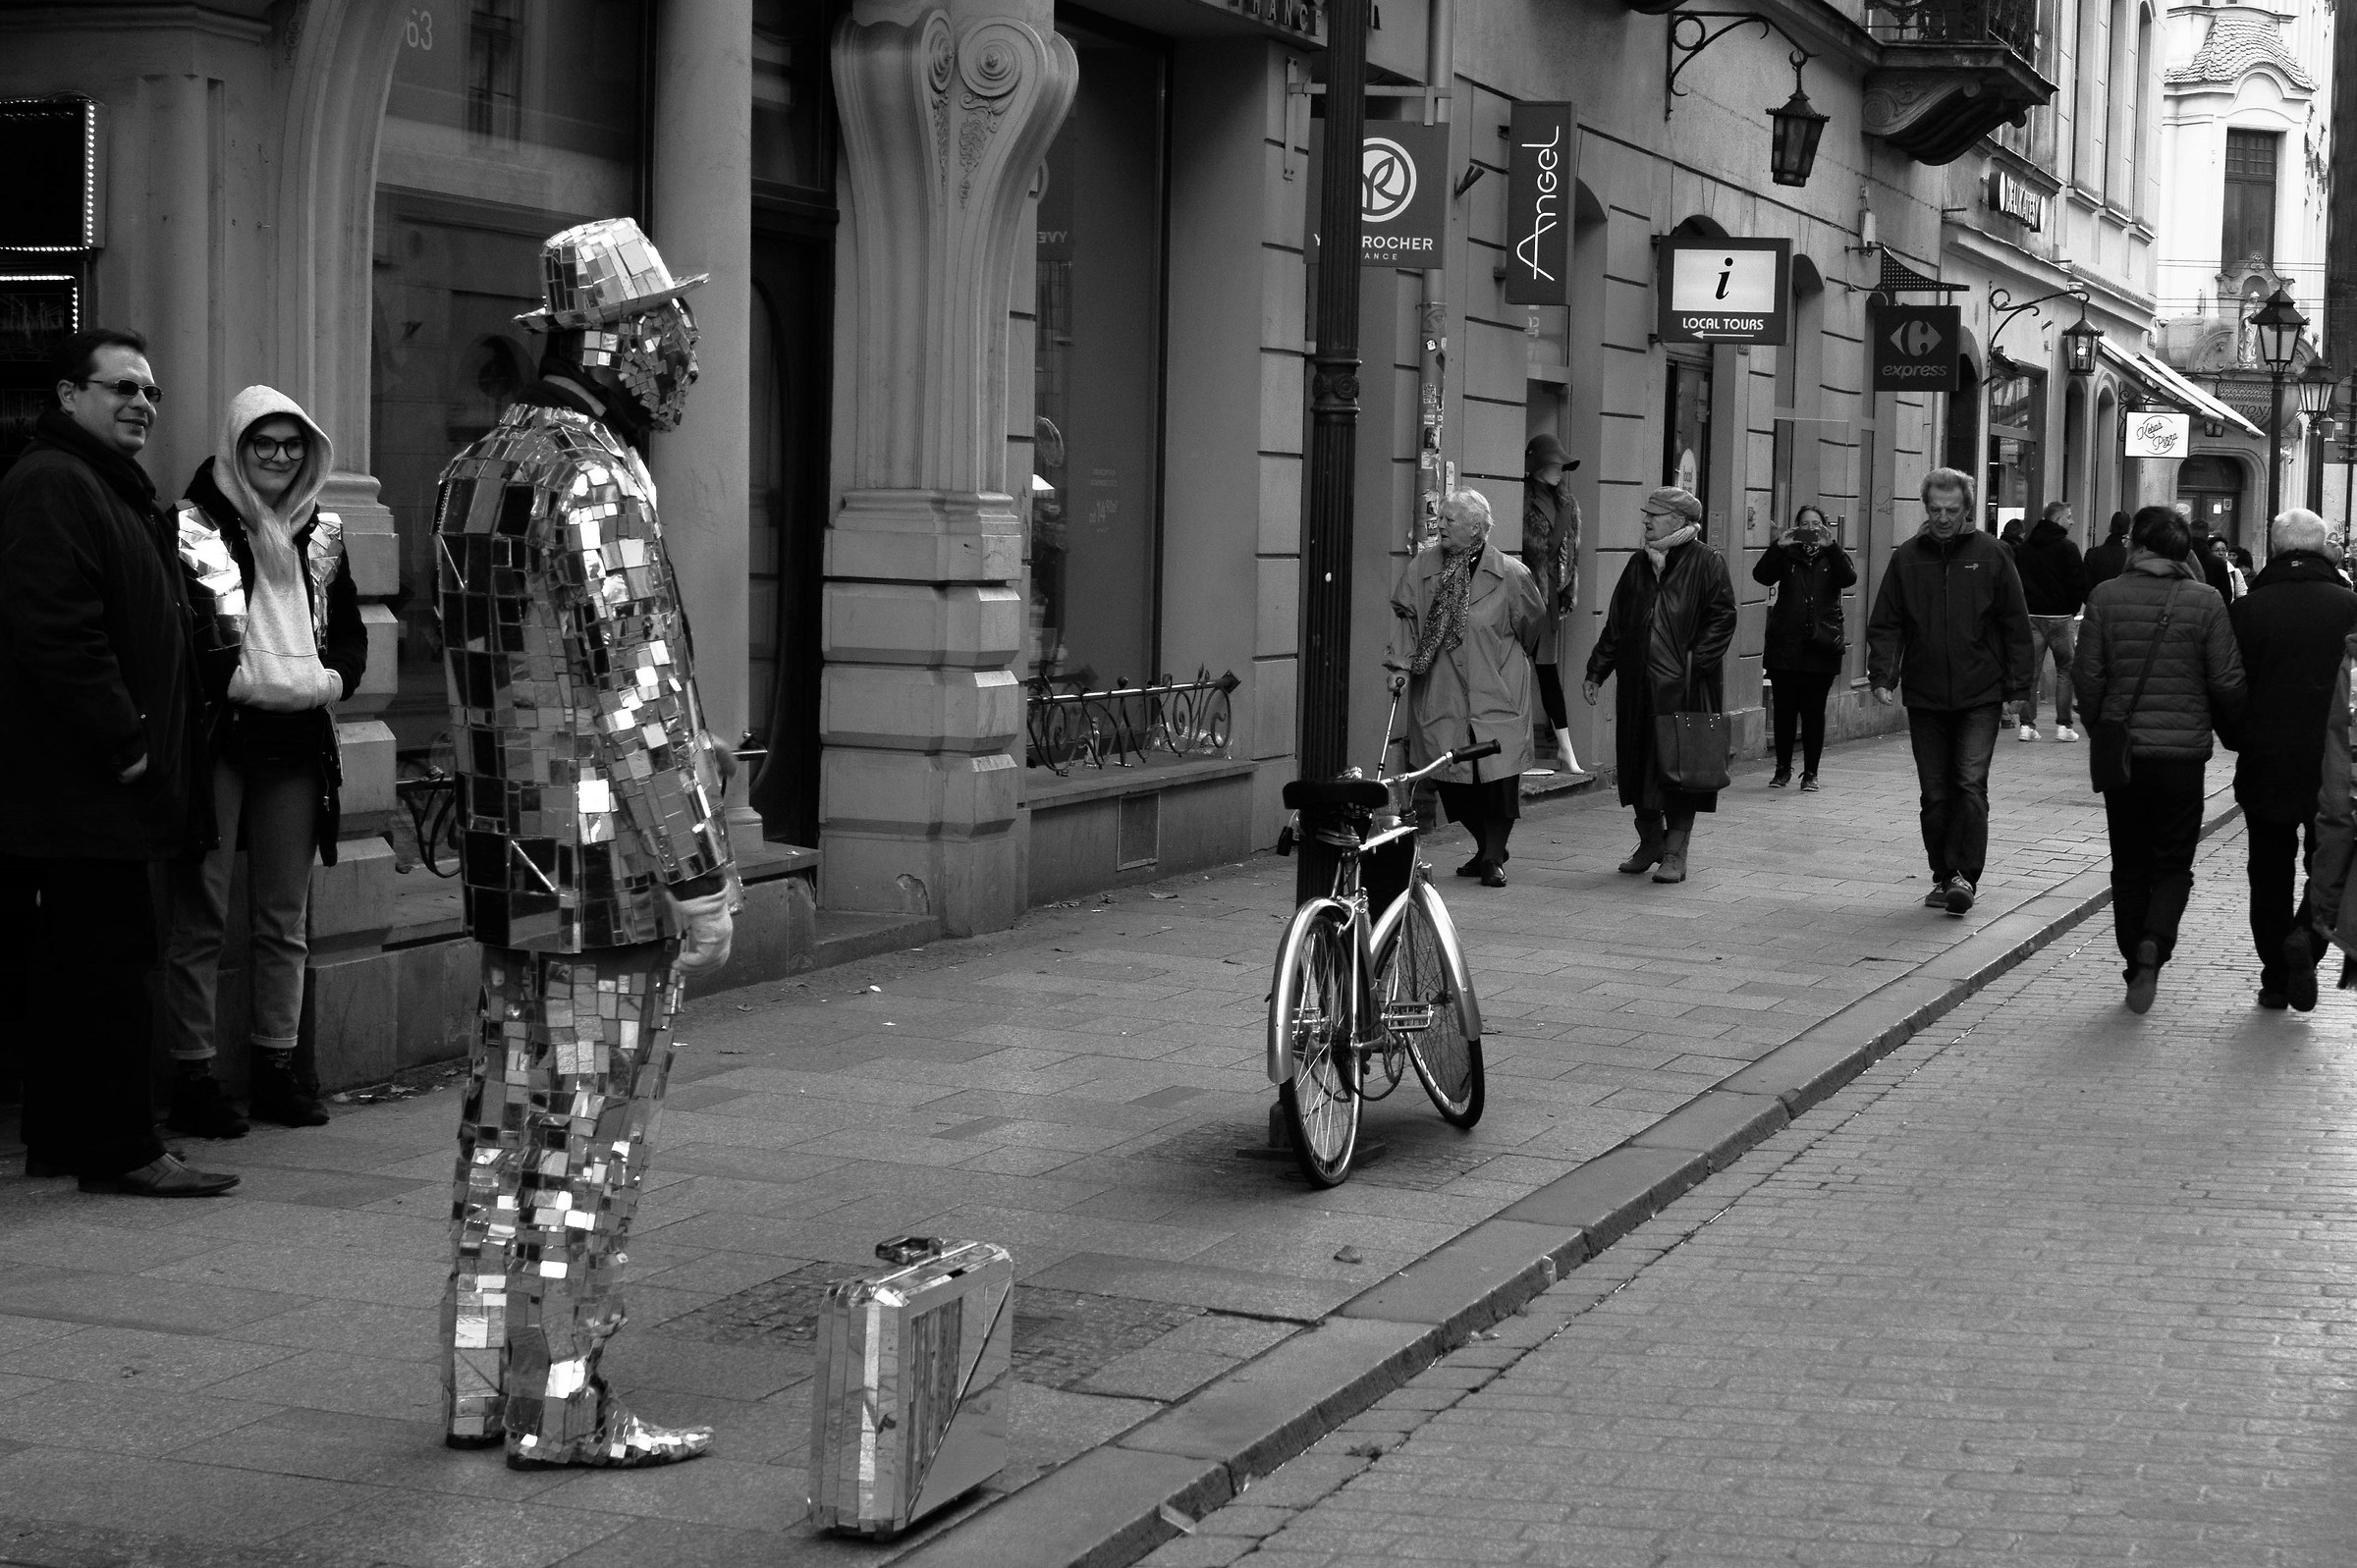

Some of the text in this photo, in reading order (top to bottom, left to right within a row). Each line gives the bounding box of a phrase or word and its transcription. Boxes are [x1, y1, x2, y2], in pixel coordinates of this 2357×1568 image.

[1234, 0, 1323, 37] RANCE
[1361, 236, 1434, 250] ROCHER
[1715, 257, 1734, 300] i
[1682, 317, 1764, 331] LOCAL TOURS
[1882, 364, 1947, 379] express
[2136, 420, 2163, 441] Kebab
[2152, 432, 2178, 451] Pizza
